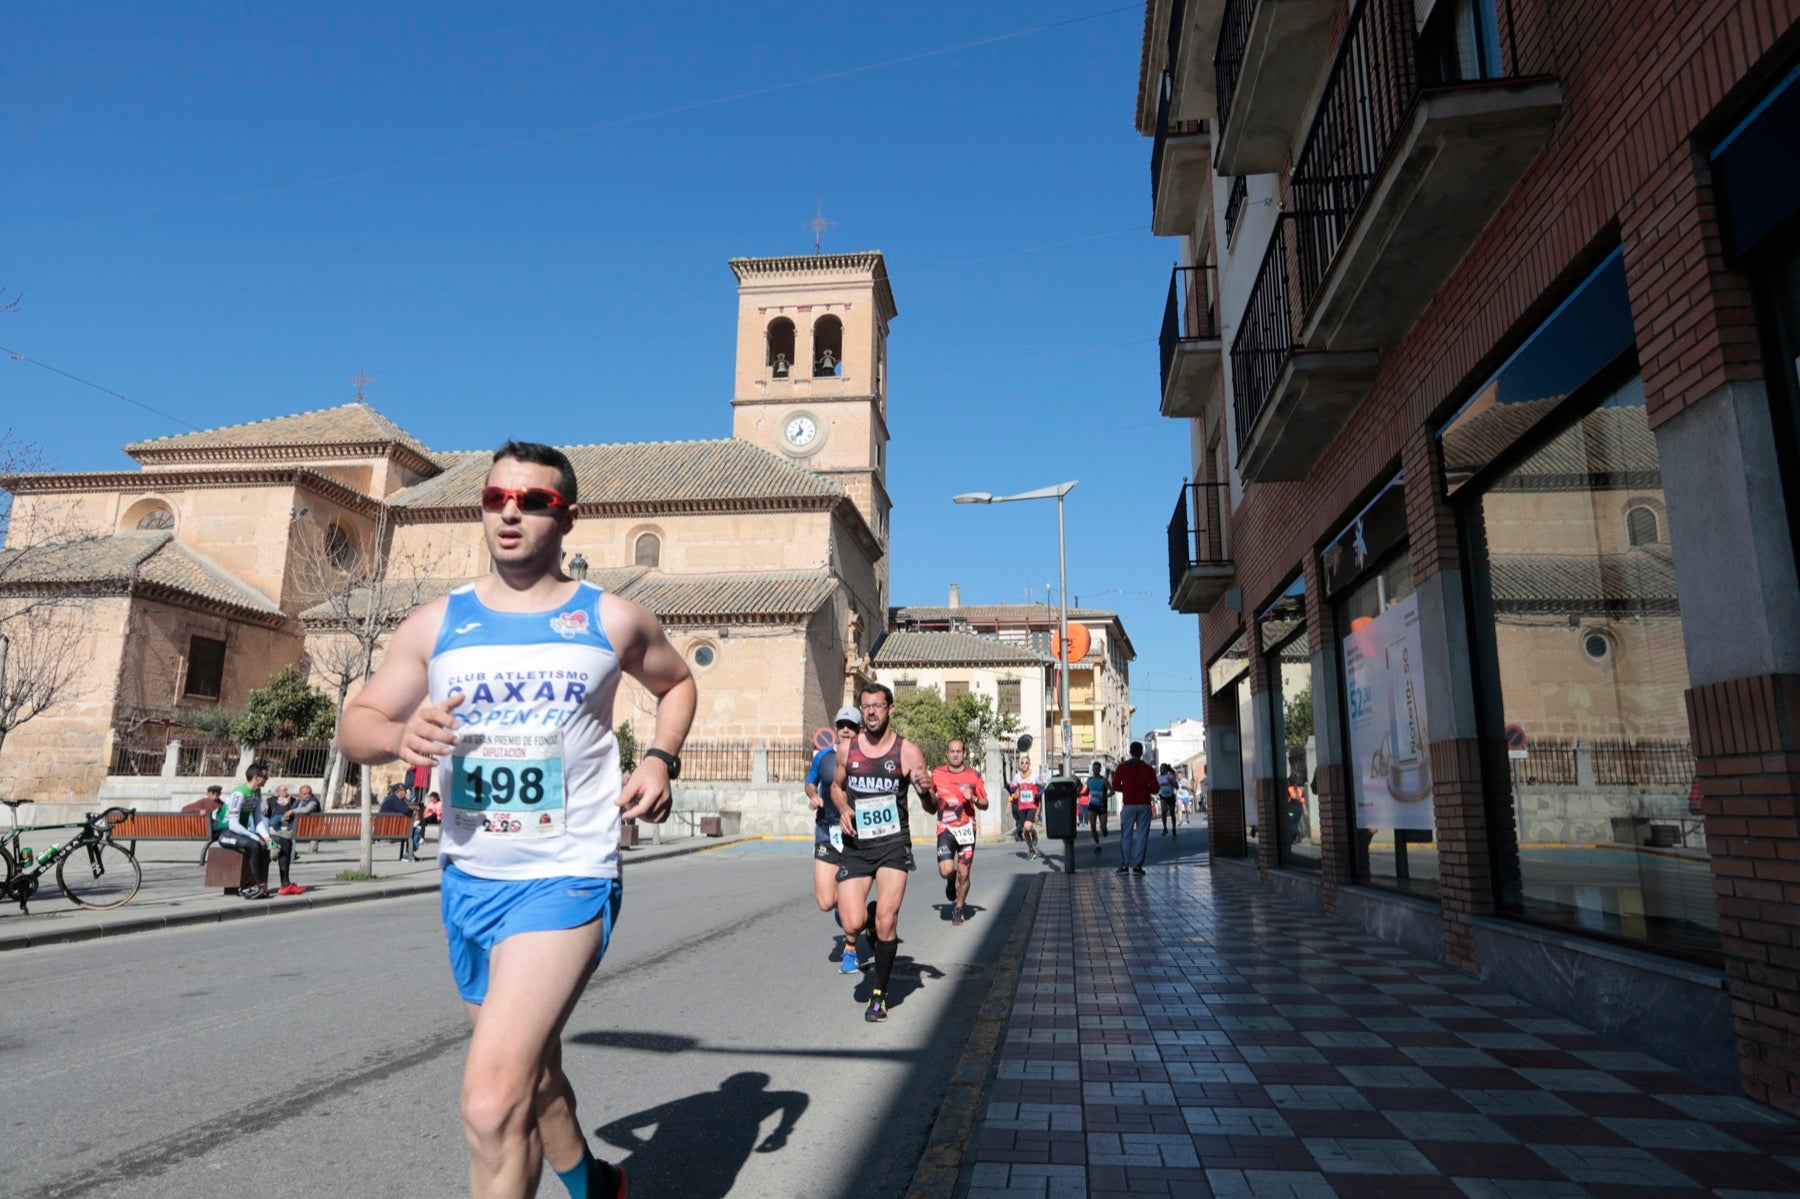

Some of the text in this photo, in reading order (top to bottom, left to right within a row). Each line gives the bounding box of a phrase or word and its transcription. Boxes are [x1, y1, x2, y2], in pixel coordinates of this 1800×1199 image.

[448, 670, 590, 686] CLUB ATLETISMO
[494, 735, 521, 746] PREMIO
[523, 735, 532, 746] DE
[534, 734, 558, 746] FONDO
[467, 765, 544, 804] 198
[862, 808, 892, 826] 580
